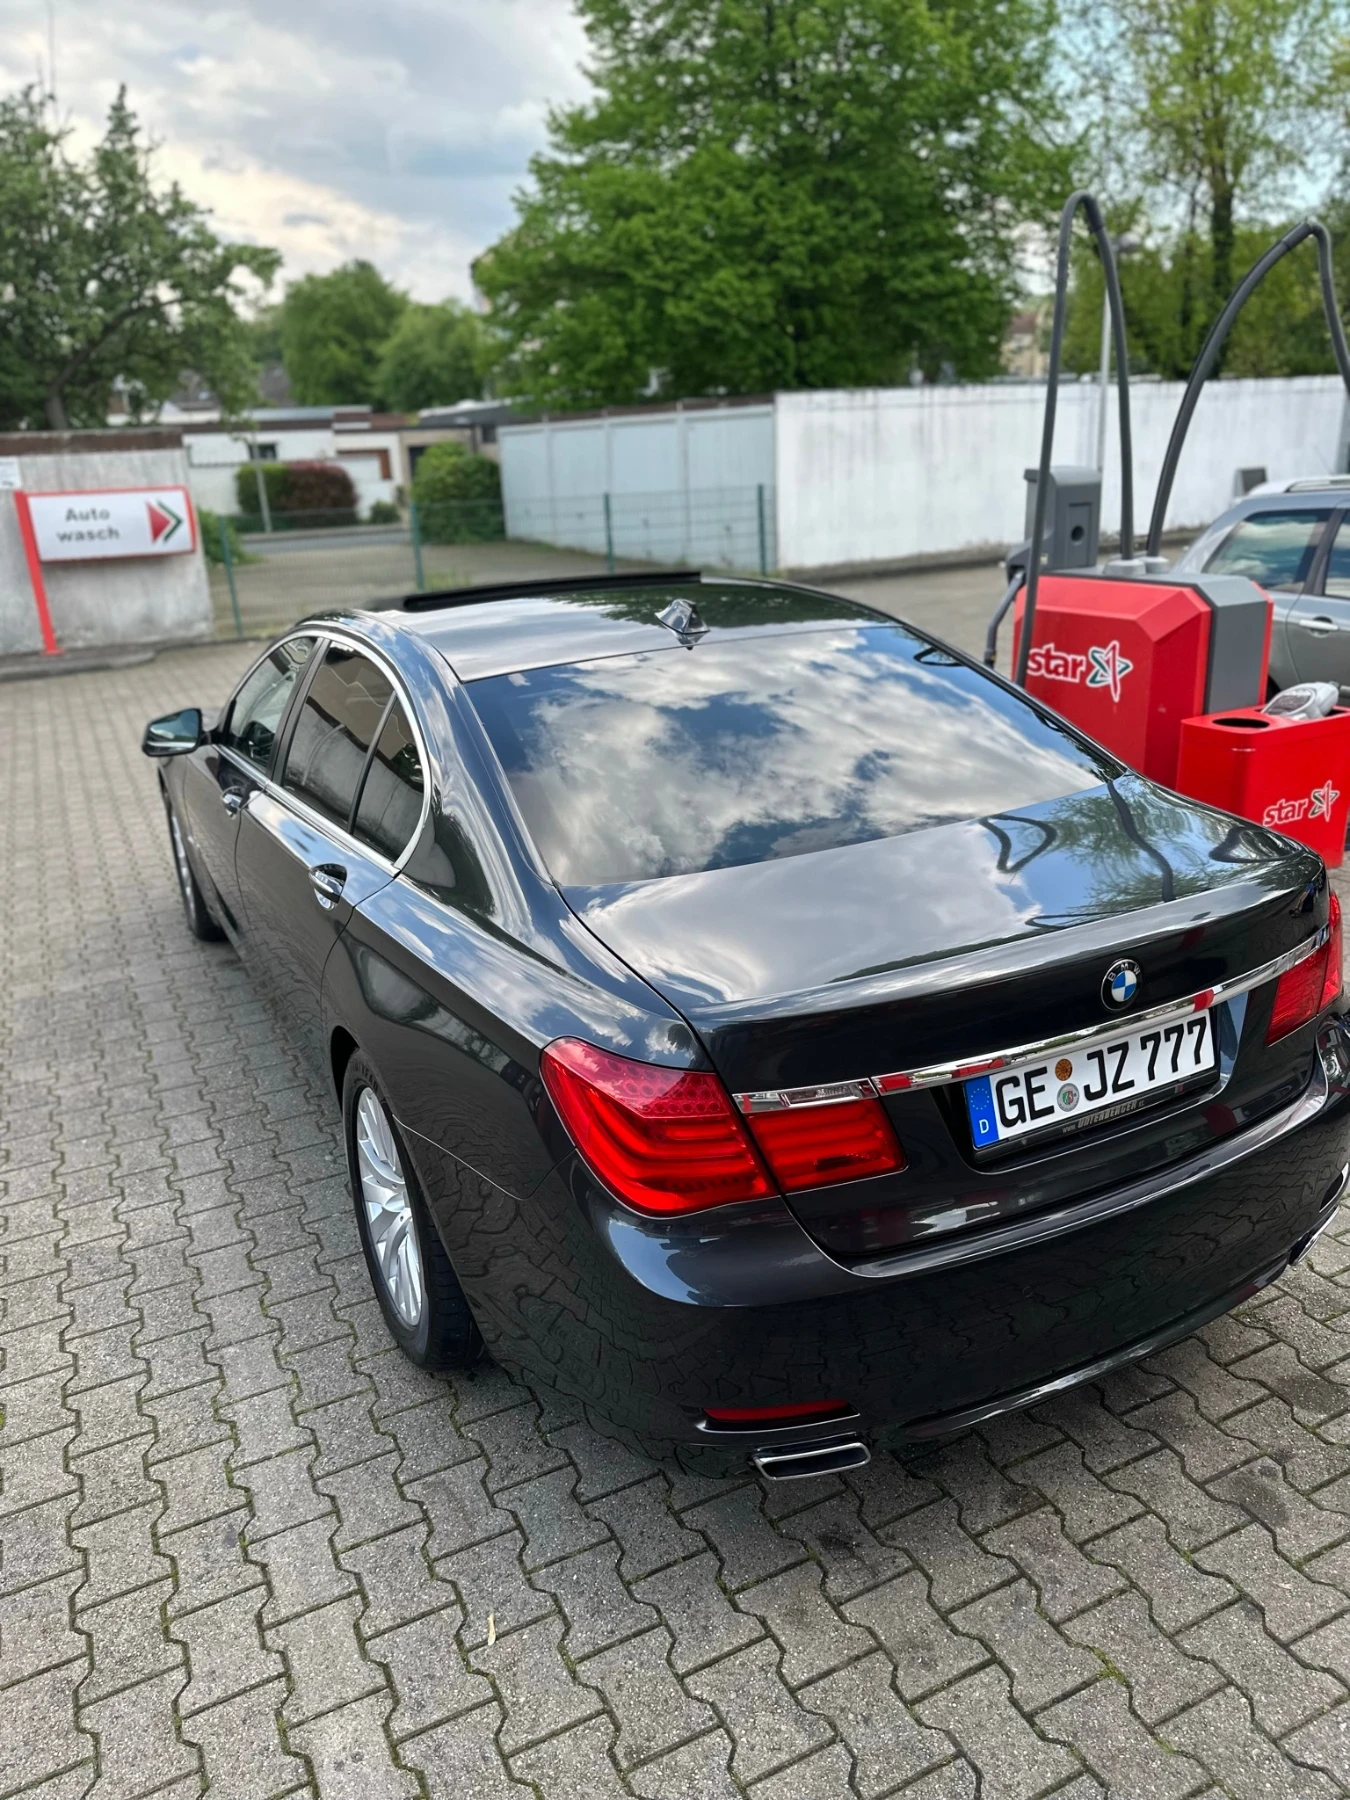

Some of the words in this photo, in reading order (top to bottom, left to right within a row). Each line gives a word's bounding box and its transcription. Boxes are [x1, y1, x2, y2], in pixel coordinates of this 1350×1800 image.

[65, 507, 110, 522] Auto
[56, 527, 120, 543] wasch
[1027, 643, 1087, 683] star
[1263, 798, 1309, 827] star
[1107, 962, 1141, 982] BMW
[995, 1066, 1055, 1128] GE
[1083, 1042, 1135, 1101] JZ
[1139, 1016, 1208, 1081] 777
[978, 1118, 990, 1134] D
